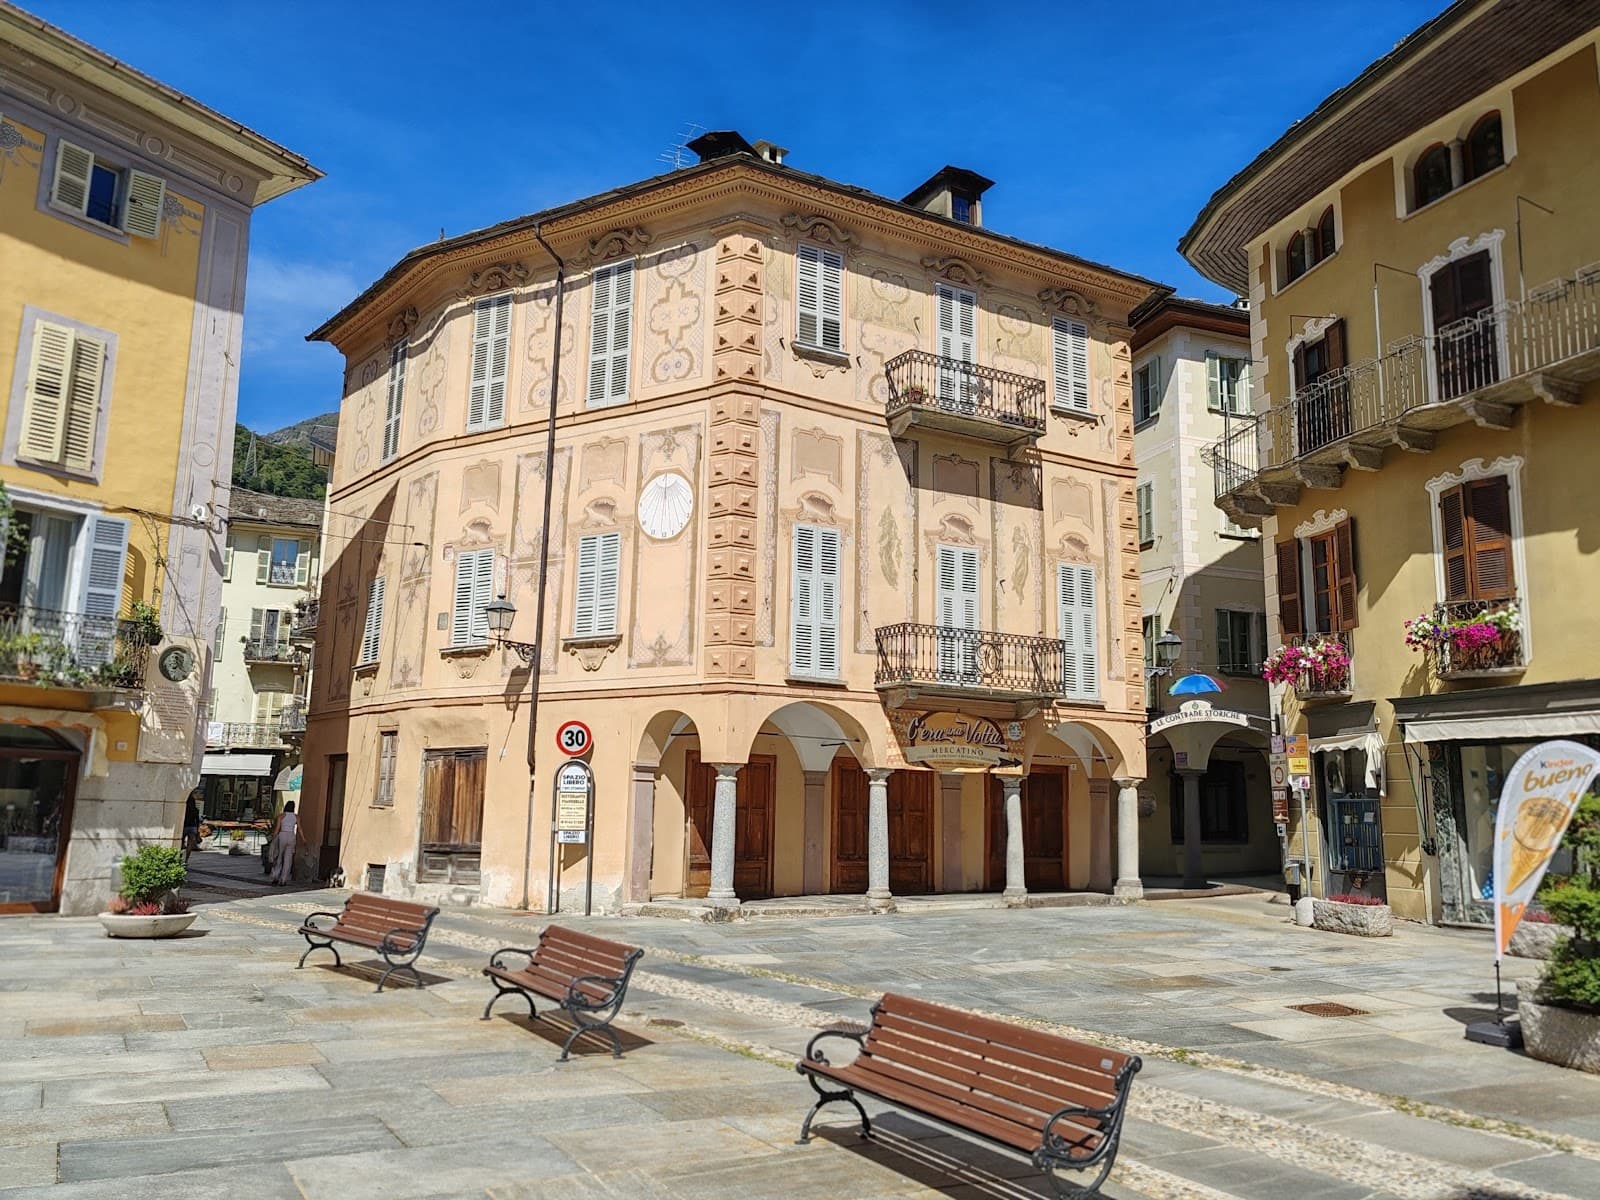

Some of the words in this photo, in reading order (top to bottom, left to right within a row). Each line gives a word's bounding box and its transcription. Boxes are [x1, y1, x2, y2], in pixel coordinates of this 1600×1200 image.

[1164, 711, 1202, 721] CONTRADE
[1205, 710, 1241, 720] STORICHE
[564, 730, 585, 747] 30
[956, 719, 1008, 750] Volta
[932, 746, 984, 755] MERCATINO
[1524, 763, 1593, 792] bueno
